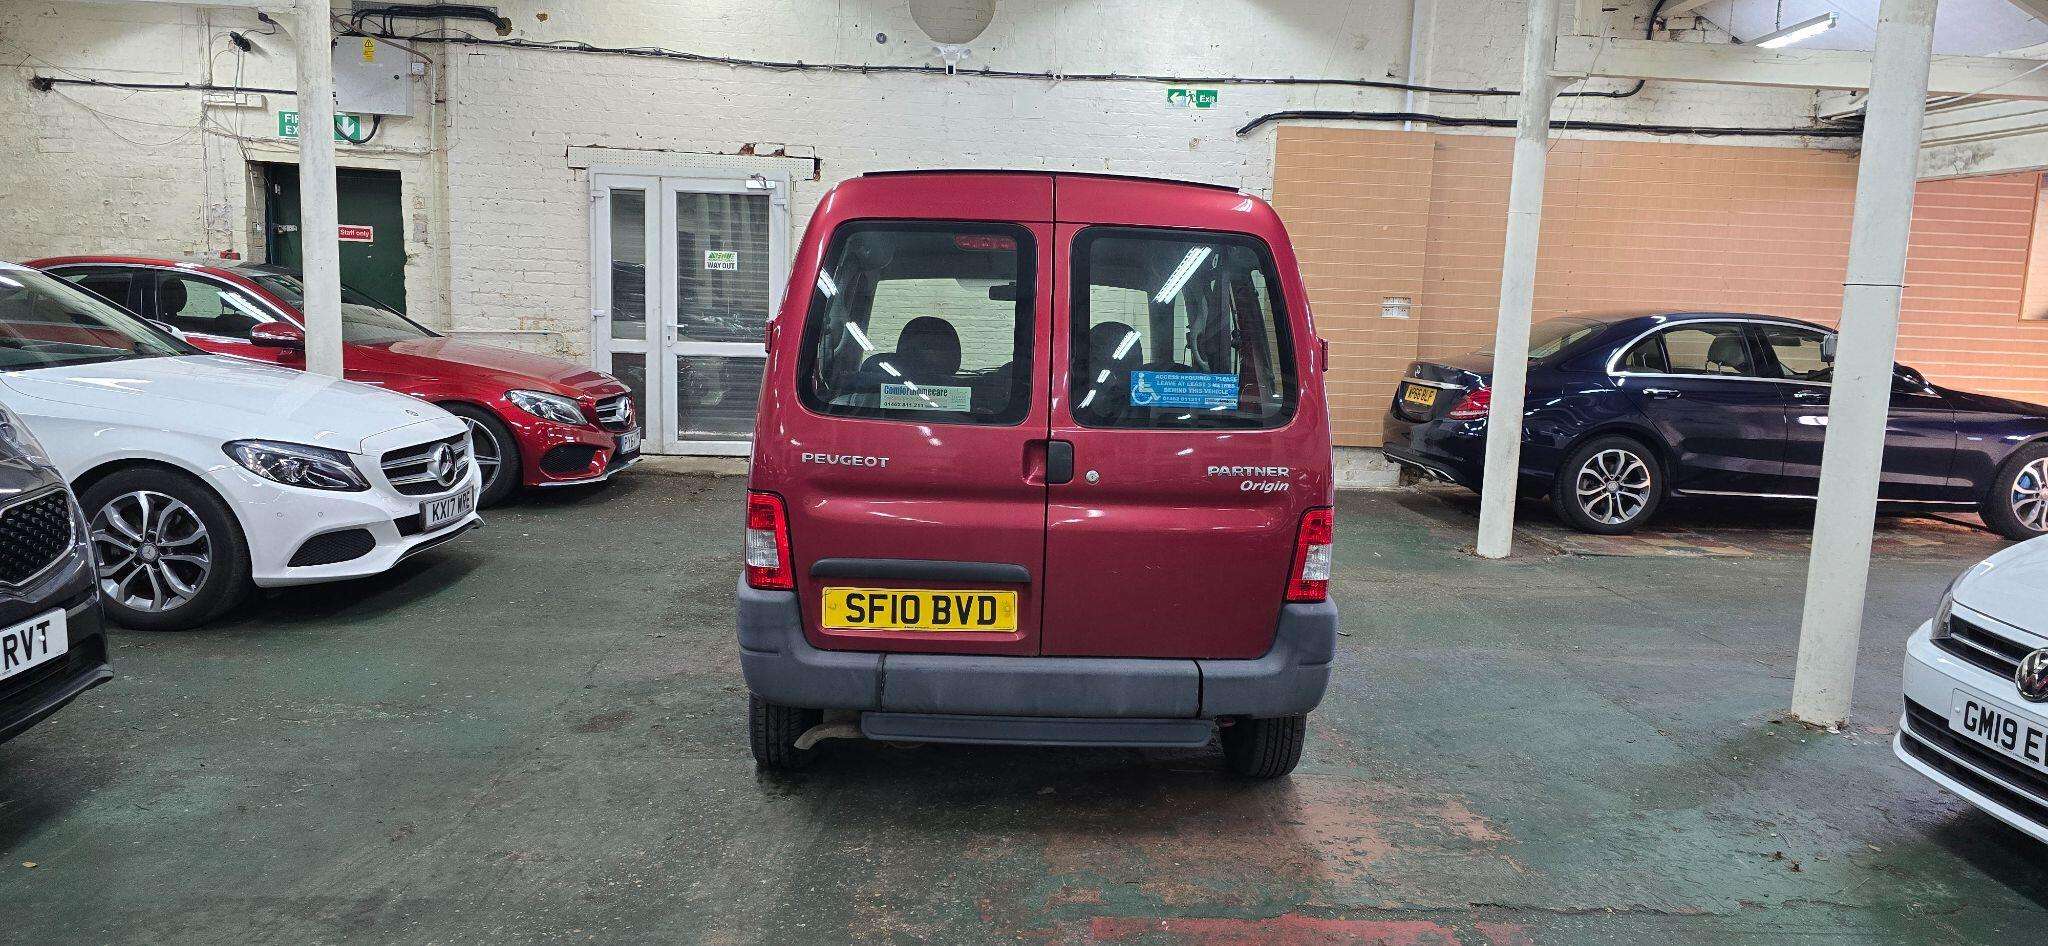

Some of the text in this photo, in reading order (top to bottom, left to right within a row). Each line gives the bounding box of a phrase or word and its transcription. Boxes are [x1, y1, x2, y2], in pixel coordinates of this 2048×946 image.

[1200, 95, 1216, 103] Exit
[284, 113, 300, 124] FIR
[285, 125, 299, 135] EX
[355, 230, 370, 238] only
[707, 261, 721, 269] WAY
[722, 262, 735, 270] OUT
[801, 452, 890, 468] PEUGEOT
[1207, 465, 1290, 478] PARTNER
[1240, 480, 1290, 493] Origin
[432, 498, 456, 522] KX17
[845, 592, 997, 625] SF10 BVD
[3, 620, 50, 670] RVT
[1963, 700, 2018, 750] GM19
[2024, 726, 2048, 767] E
